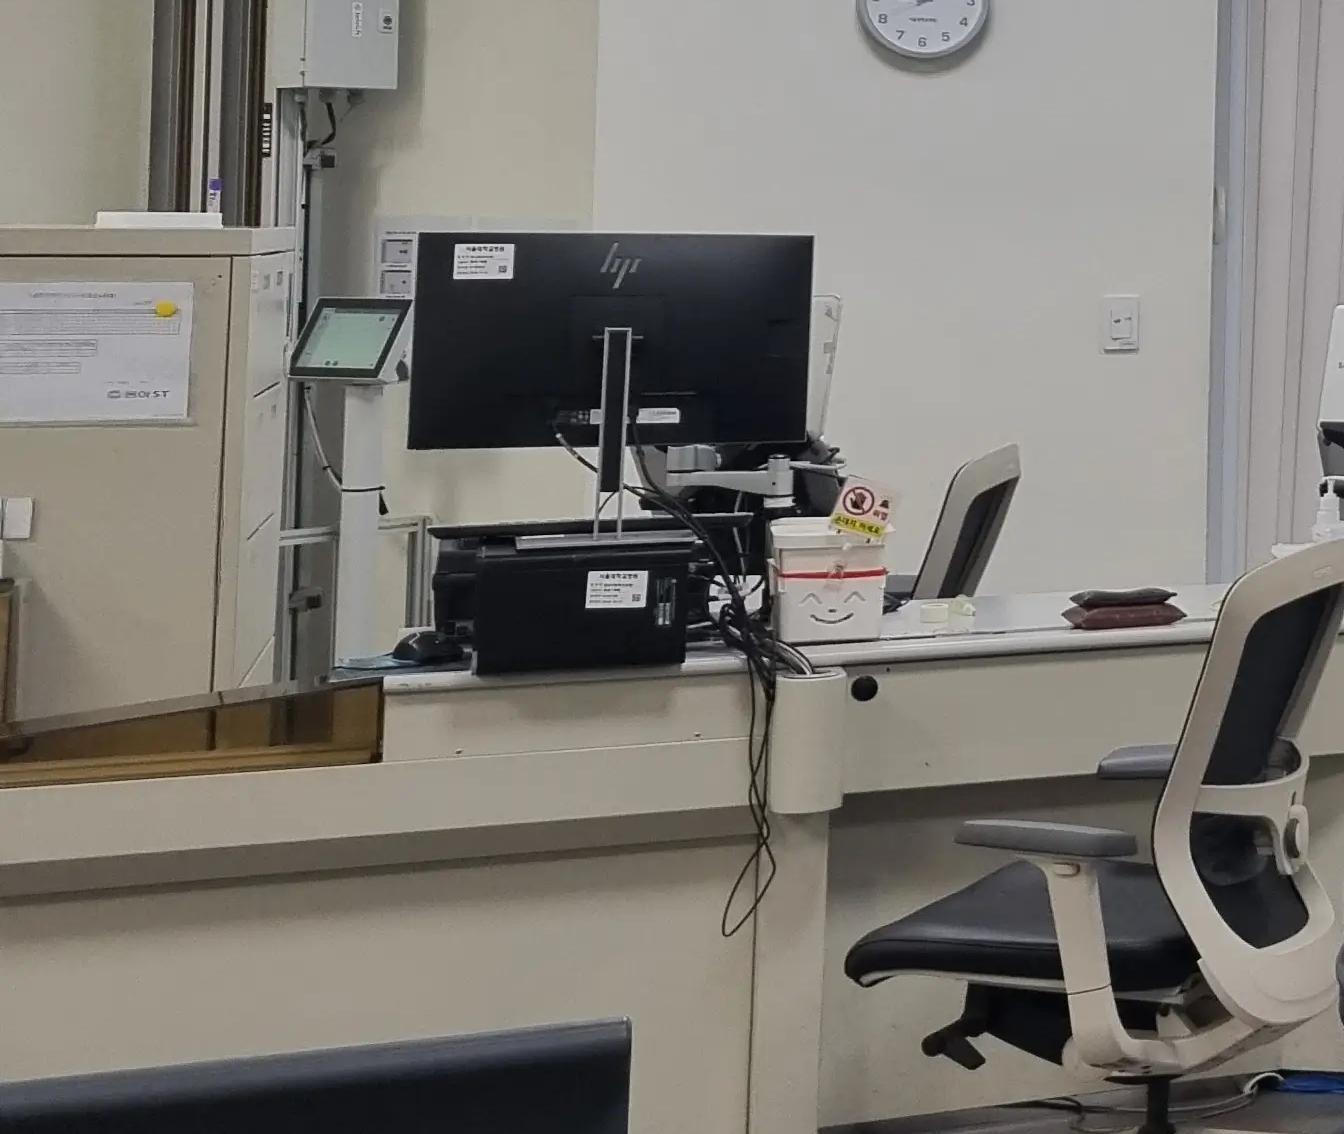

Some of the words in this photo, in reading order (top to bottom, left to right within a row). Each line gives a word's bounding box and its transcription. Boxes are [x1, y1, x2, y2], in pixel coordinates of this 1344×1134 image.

[879, 14, 887, 23] 8
[959, 17, 968, 26] 4
[896, 30, 905, 40] 7
[942, 32, 950, 41] 5
[918, 37, 927, 47] 6
